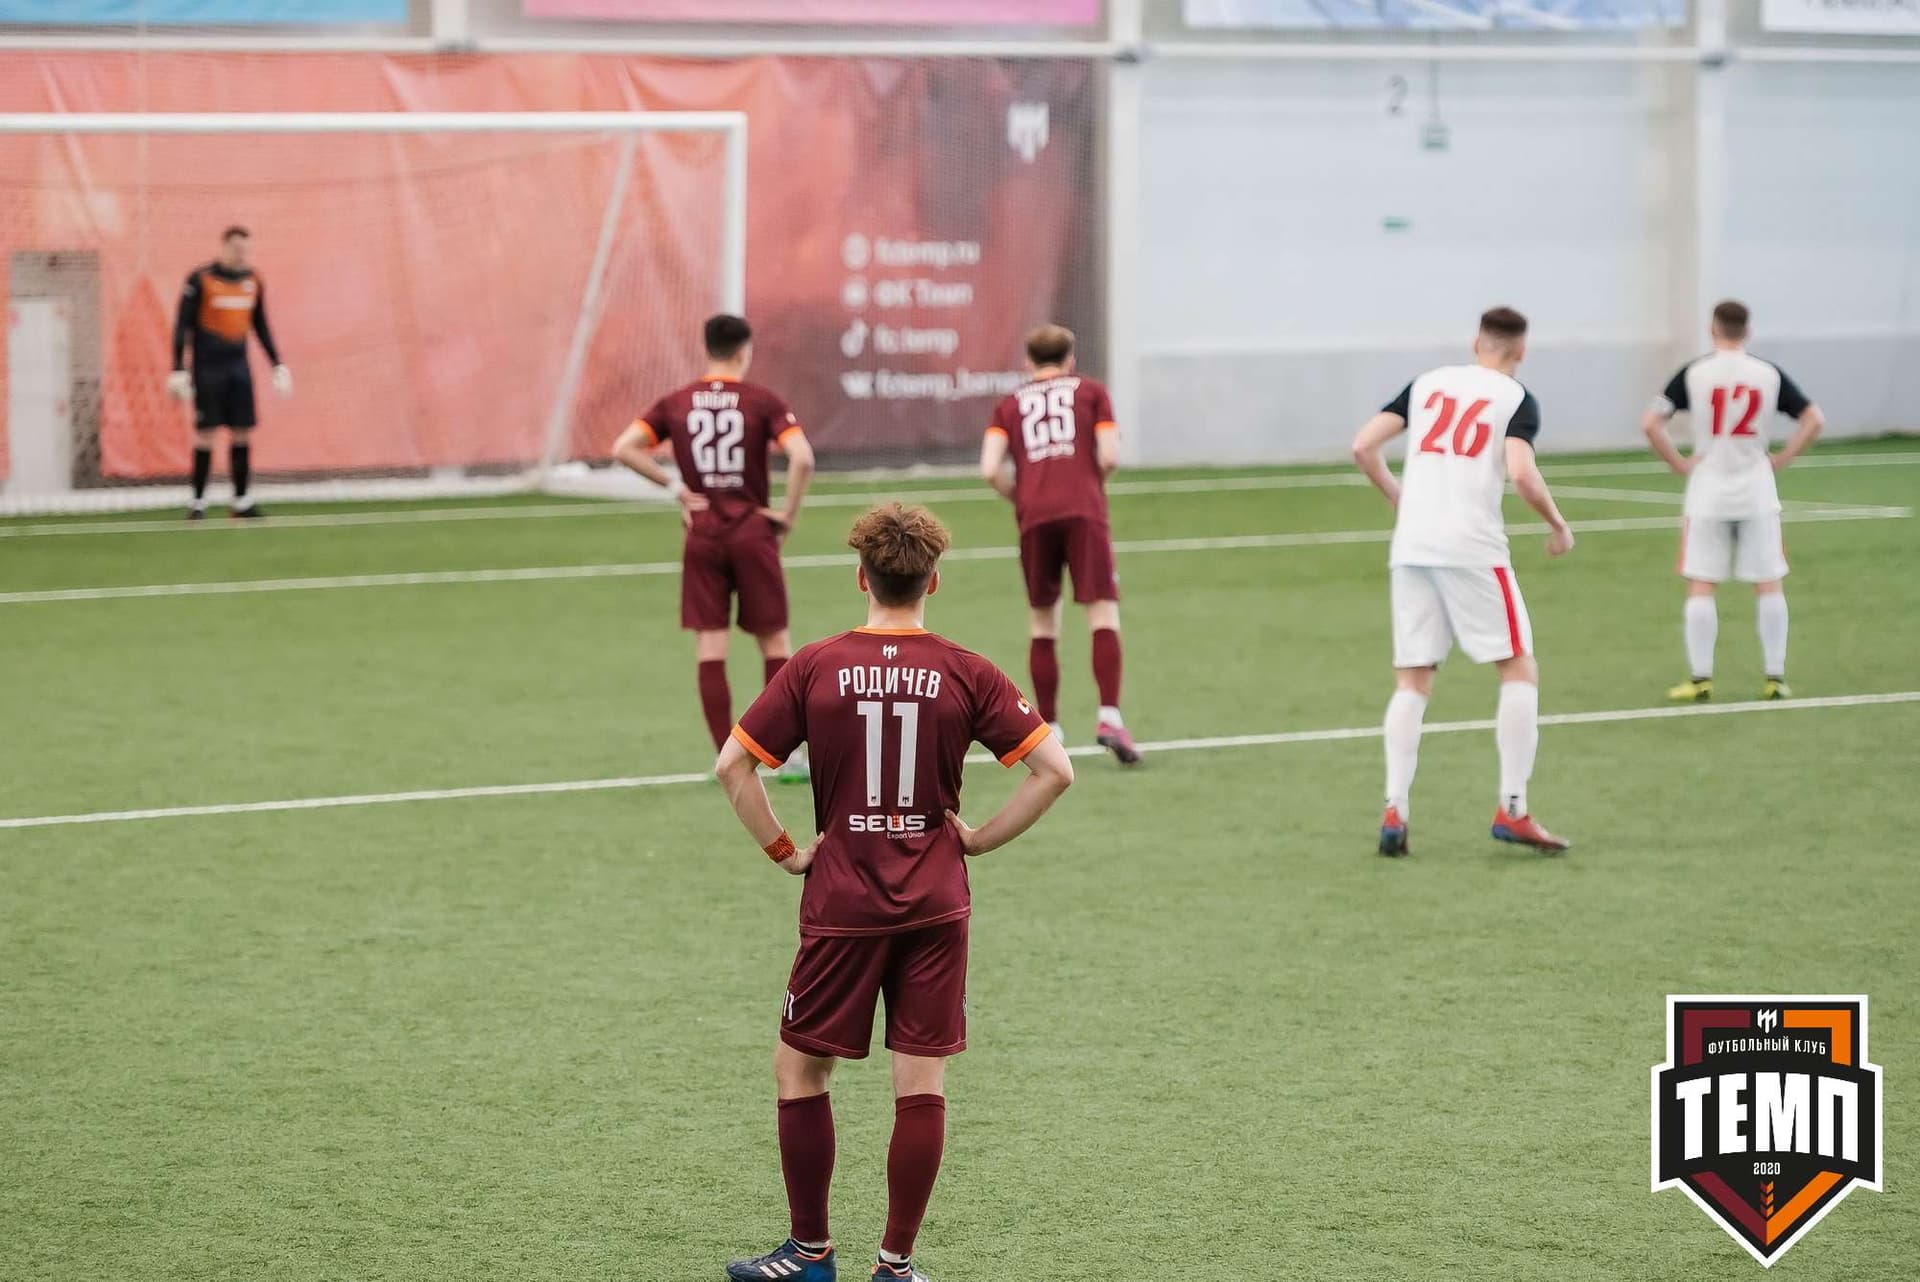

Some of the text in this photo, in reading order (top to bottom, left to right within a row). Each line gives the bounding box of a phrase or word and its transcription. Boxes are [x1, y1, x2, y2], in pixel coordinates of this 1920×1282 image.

[687, 409, 744, 473] 22
[1019, 387, 1076, 452] 25
[1420, 391, 1491, 457] 26
[1711, 385, 1761, 436] 12
[838, 666, 942, 698] РОДИЧЕВ
[857, 701, 919, 807] 11
[849, 814, 926, 832] SEUS
